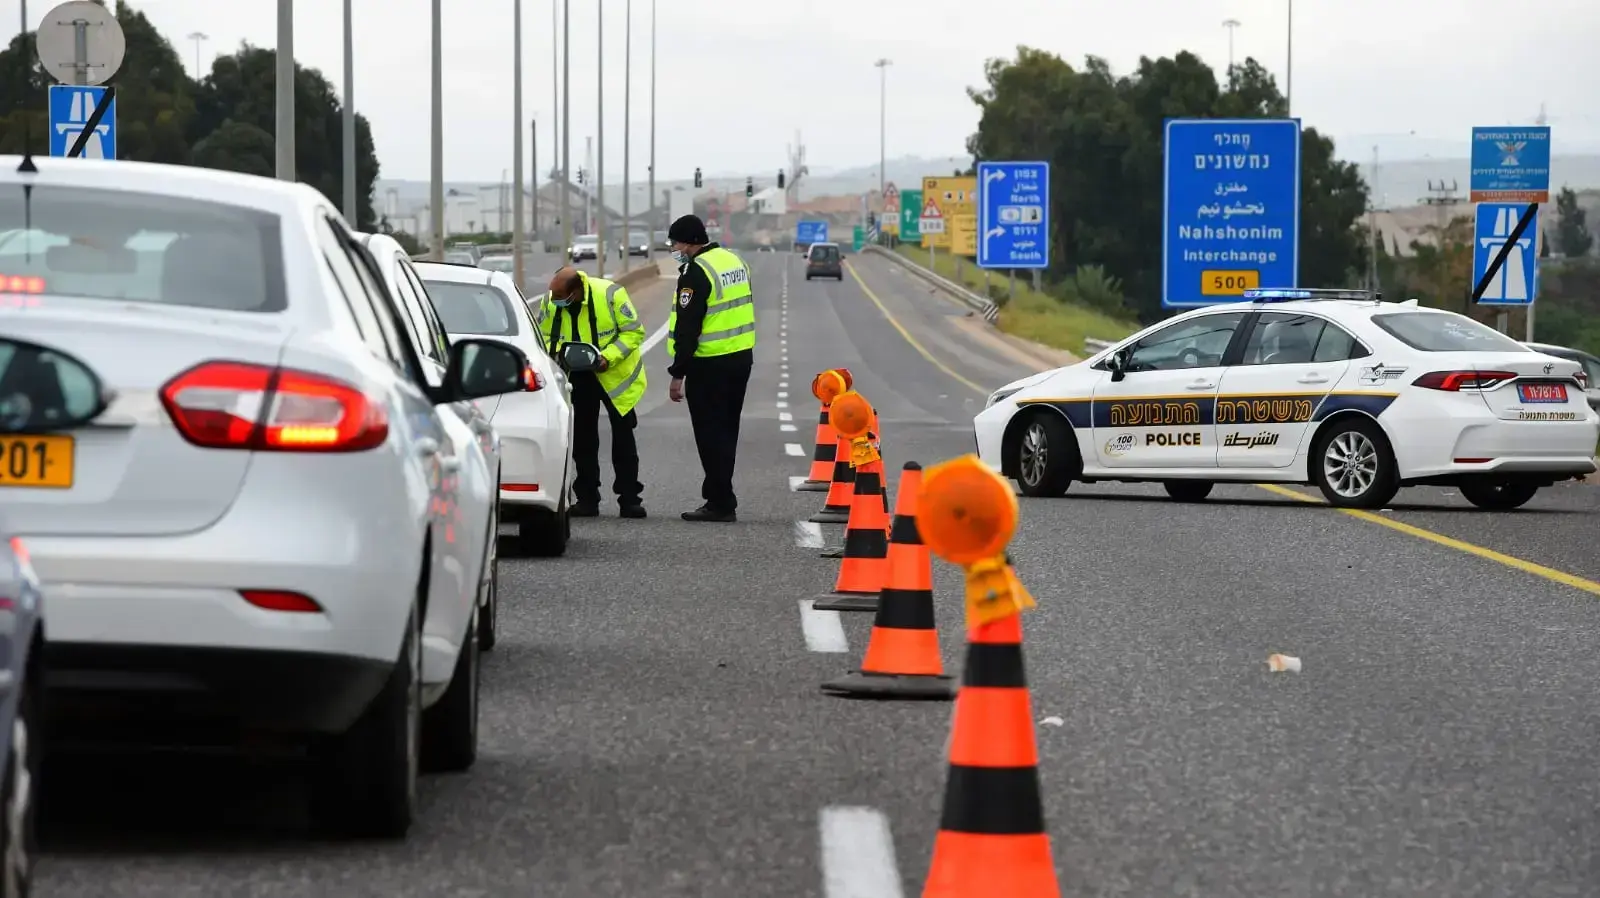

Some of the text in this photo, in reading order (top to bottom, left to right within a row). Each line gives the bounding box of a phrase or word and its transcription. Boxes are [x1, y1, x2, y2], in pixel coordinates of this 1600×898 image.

[1194, 154, 1270, 170] נחשונים
[1213, 181, 1249, 197] مفترق
[1010, 193, 1041, 203] North
[1178, 224, 1283, 240] Nahshonim
[1009, 250, 1042, 261] South
[1183, 248, 1278, 264] Interchange
[720, 268, 747, 287] משטרה
[1213, 276, 1247, 289] 500
[1110, 400, 1312, 425] משטרת התנועה
[1519, 411, 1576, 420] משטרת התנועה
[1116, 435, 1133, 444] 100
[1145, 432, 1201, 447] POLICE
[1223, 430, 1280, 450] الشرطة
[0, 441, 47, 479] 01
